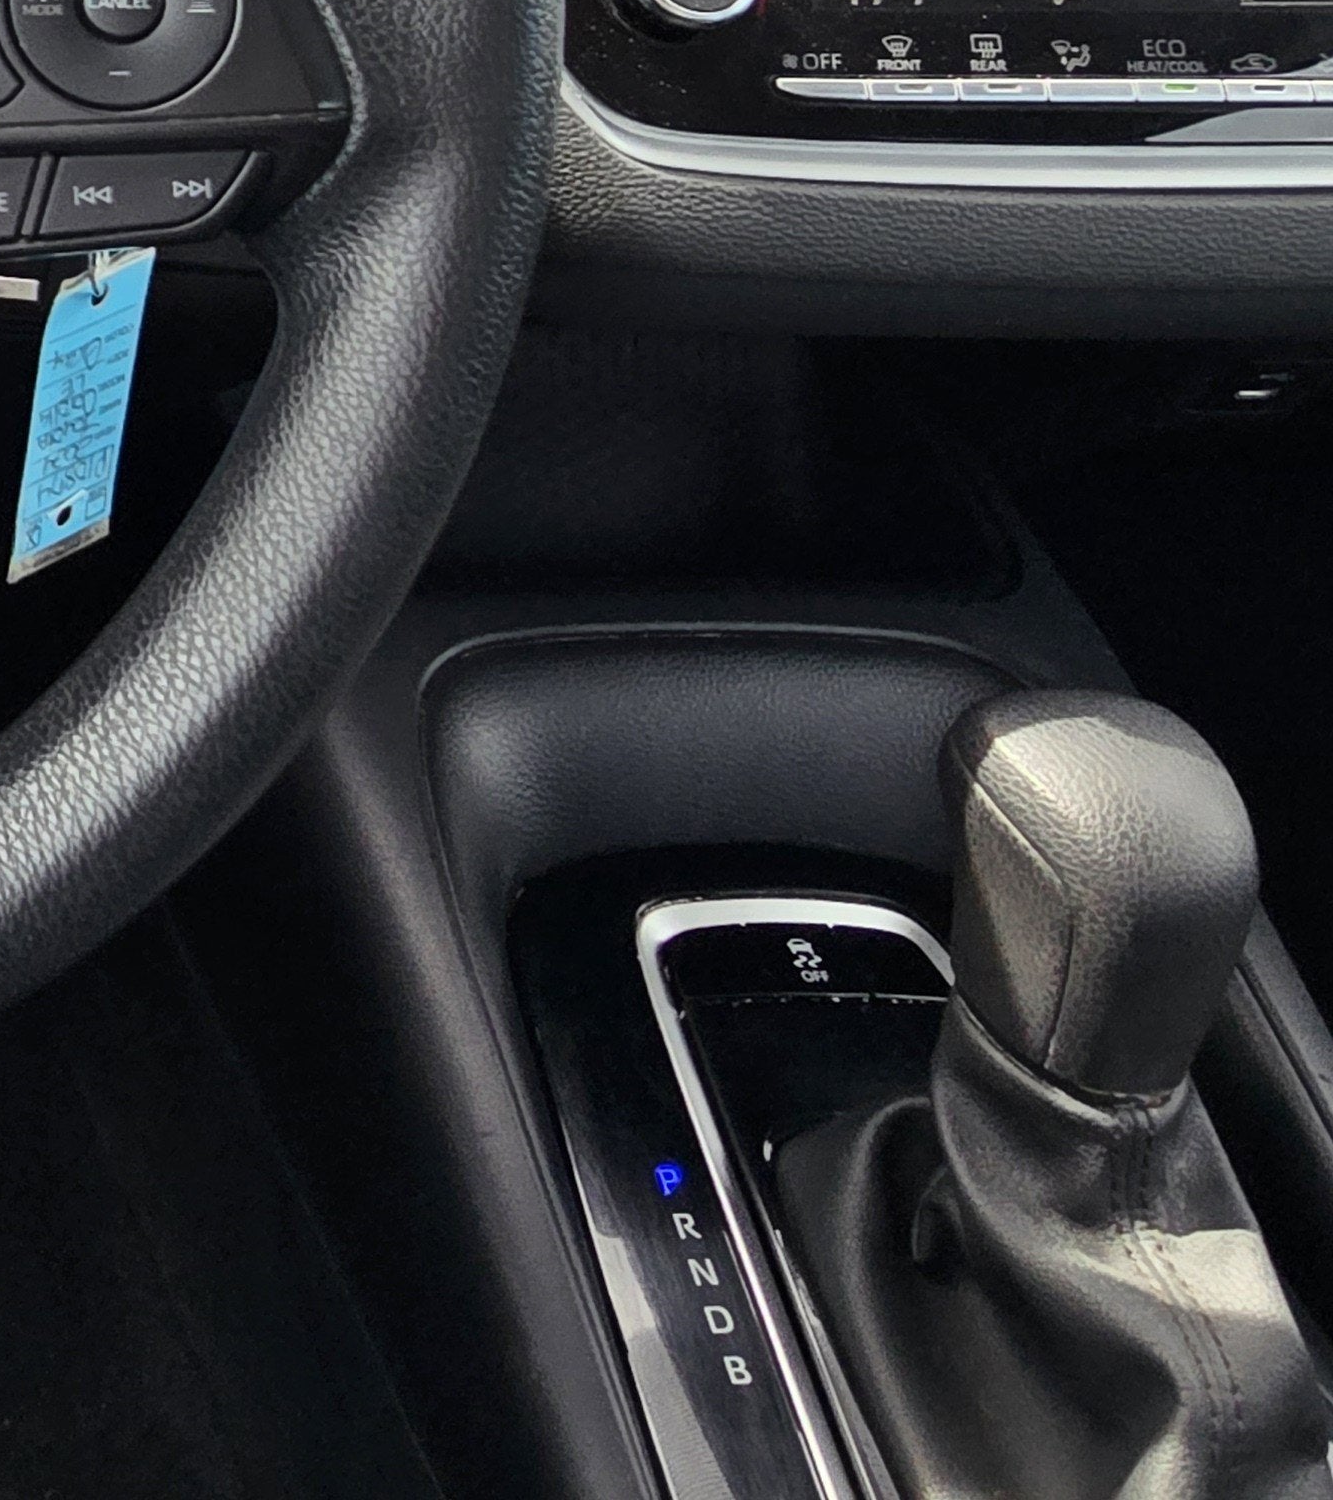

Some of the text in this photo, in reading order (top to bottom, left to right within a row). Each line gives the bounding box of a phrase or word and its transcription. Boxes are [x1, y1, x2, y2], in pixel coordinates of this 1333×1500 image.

[21, 4, 63, 16] MODE
[1142, 39, 1187, 58] ECO
[802, 53, 843, 70] OFF
[876, 59, 922, 71] FRONT
[969, 59, 1008, 71] REAR
[1126, 60, 1209, 74] HEAT/COOL
[800, 969, 830, 983] OFF
[654, 1165, 684, 1197] P
[671, 1212, 703, 1241] R
[687, 1257, 720, 1287] N
[703, 1304, 735, 1335] D
[722, 1355, 753, 1386] B
